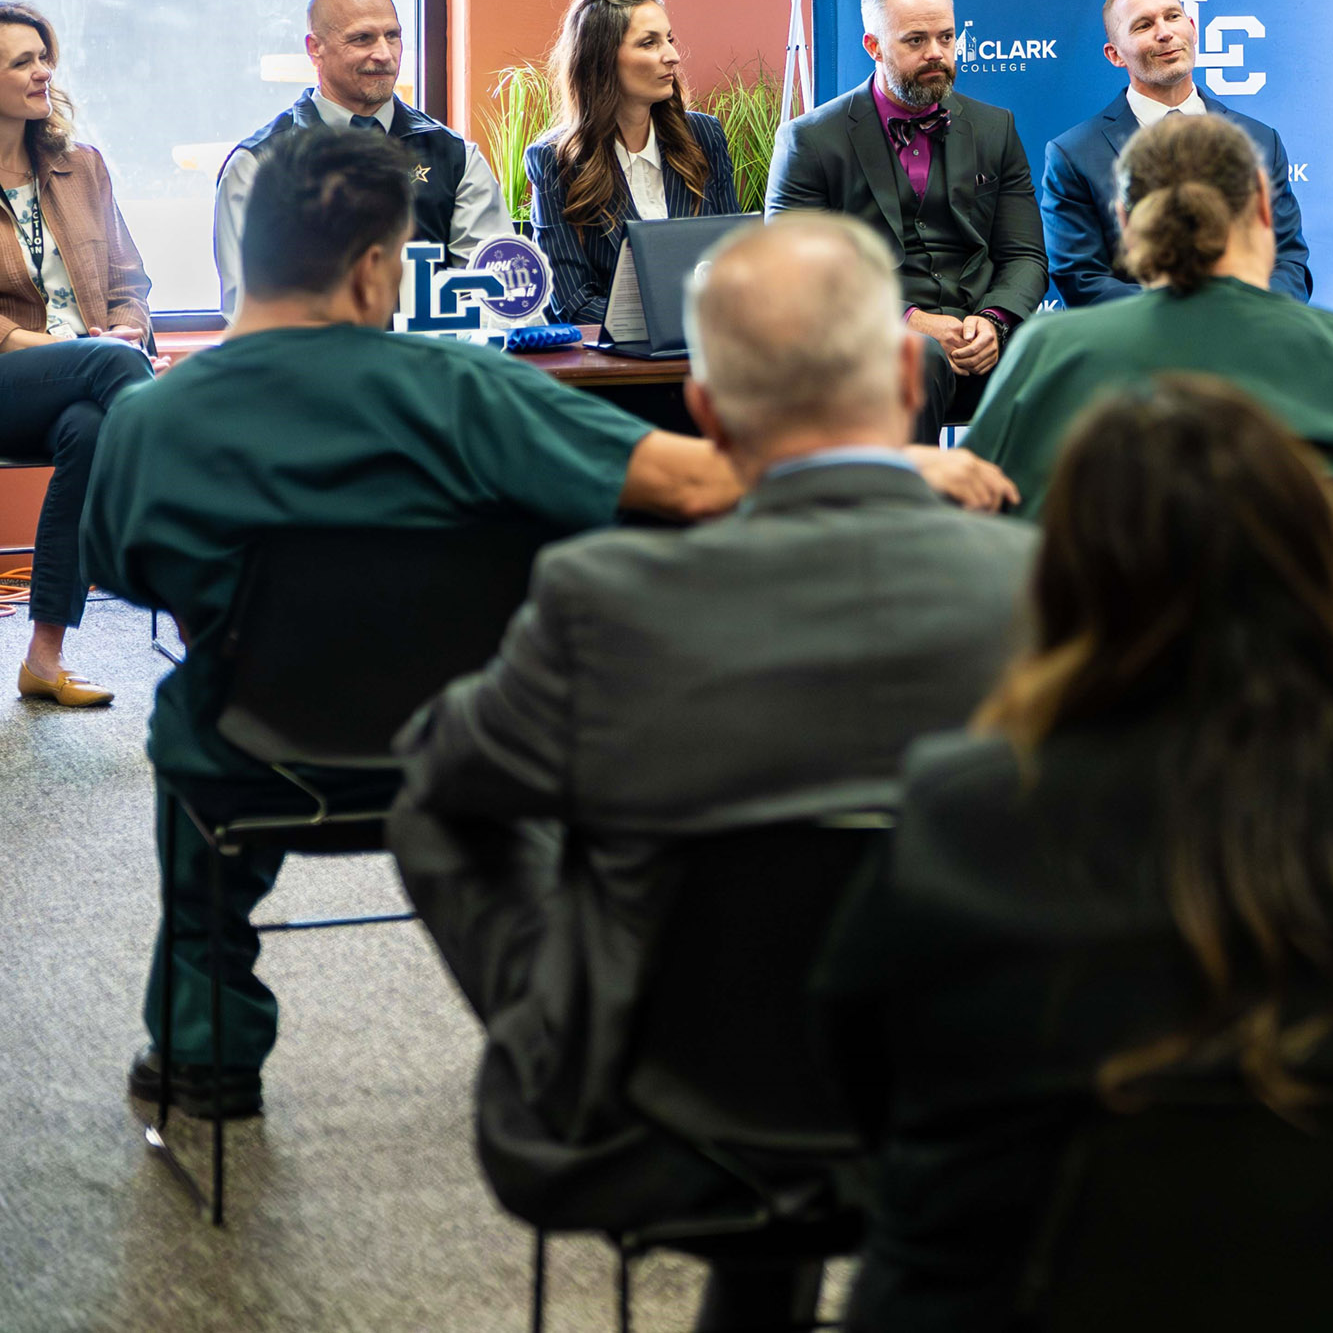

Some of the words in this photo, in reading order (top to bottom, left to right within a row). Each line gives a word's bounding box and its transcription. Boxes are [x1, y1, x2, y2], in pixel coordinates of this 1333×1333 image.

[978, 39, 1057, 60] CLARK
[960, 62, 1026, 73] COLLEGE
[32, 203, 43, 254] ACTION
